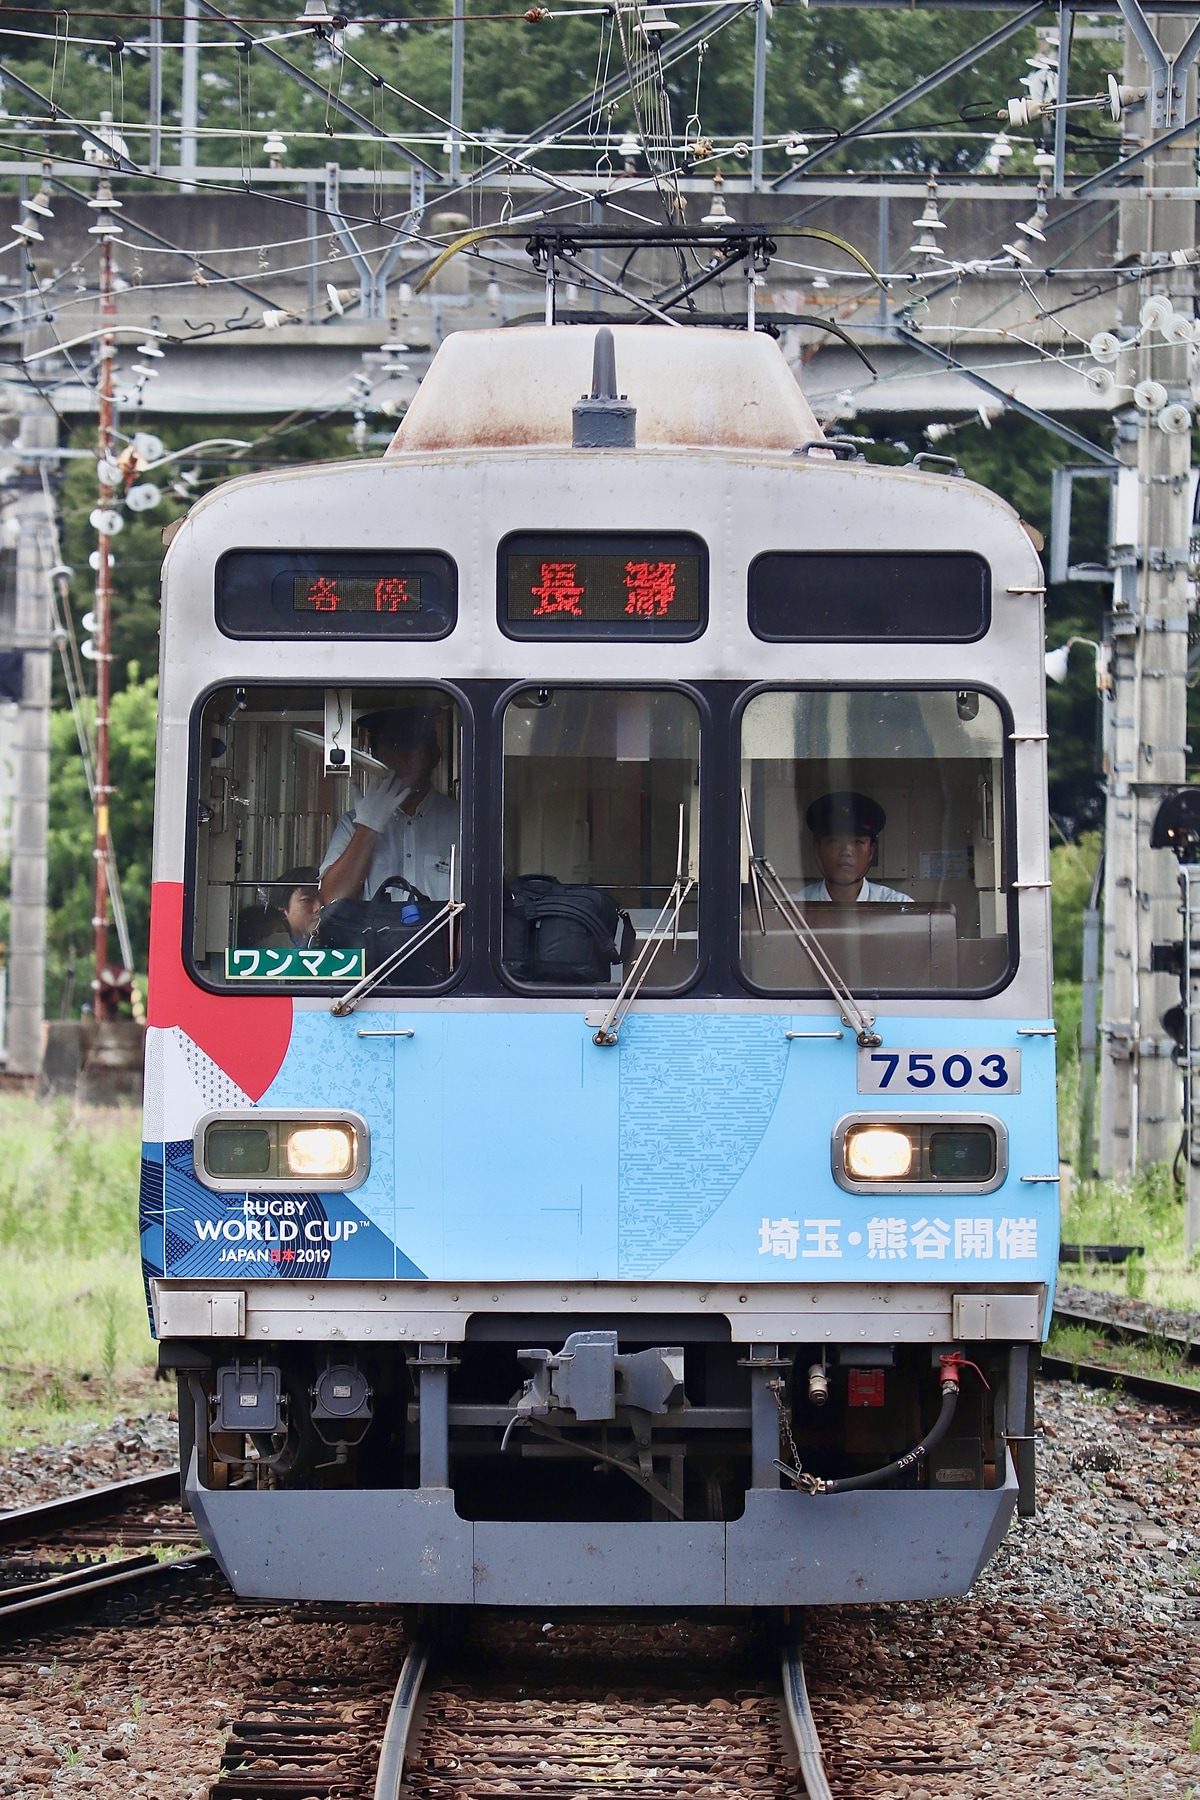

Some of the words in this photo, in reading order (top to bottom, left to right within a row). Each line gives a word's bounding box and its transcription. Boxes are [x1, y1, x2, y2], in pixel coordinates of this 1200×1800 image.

[307, 576, 408, 612] 各停
[233, 949, 359, 977] ワンマン
[870, 1054, 1009, 1089] 7503
[243, 1200, 308, 1216] RUGBY
[193, 1219, 299, 1242] WORLD
[897, 1445, 926, 1469] 2031-3
